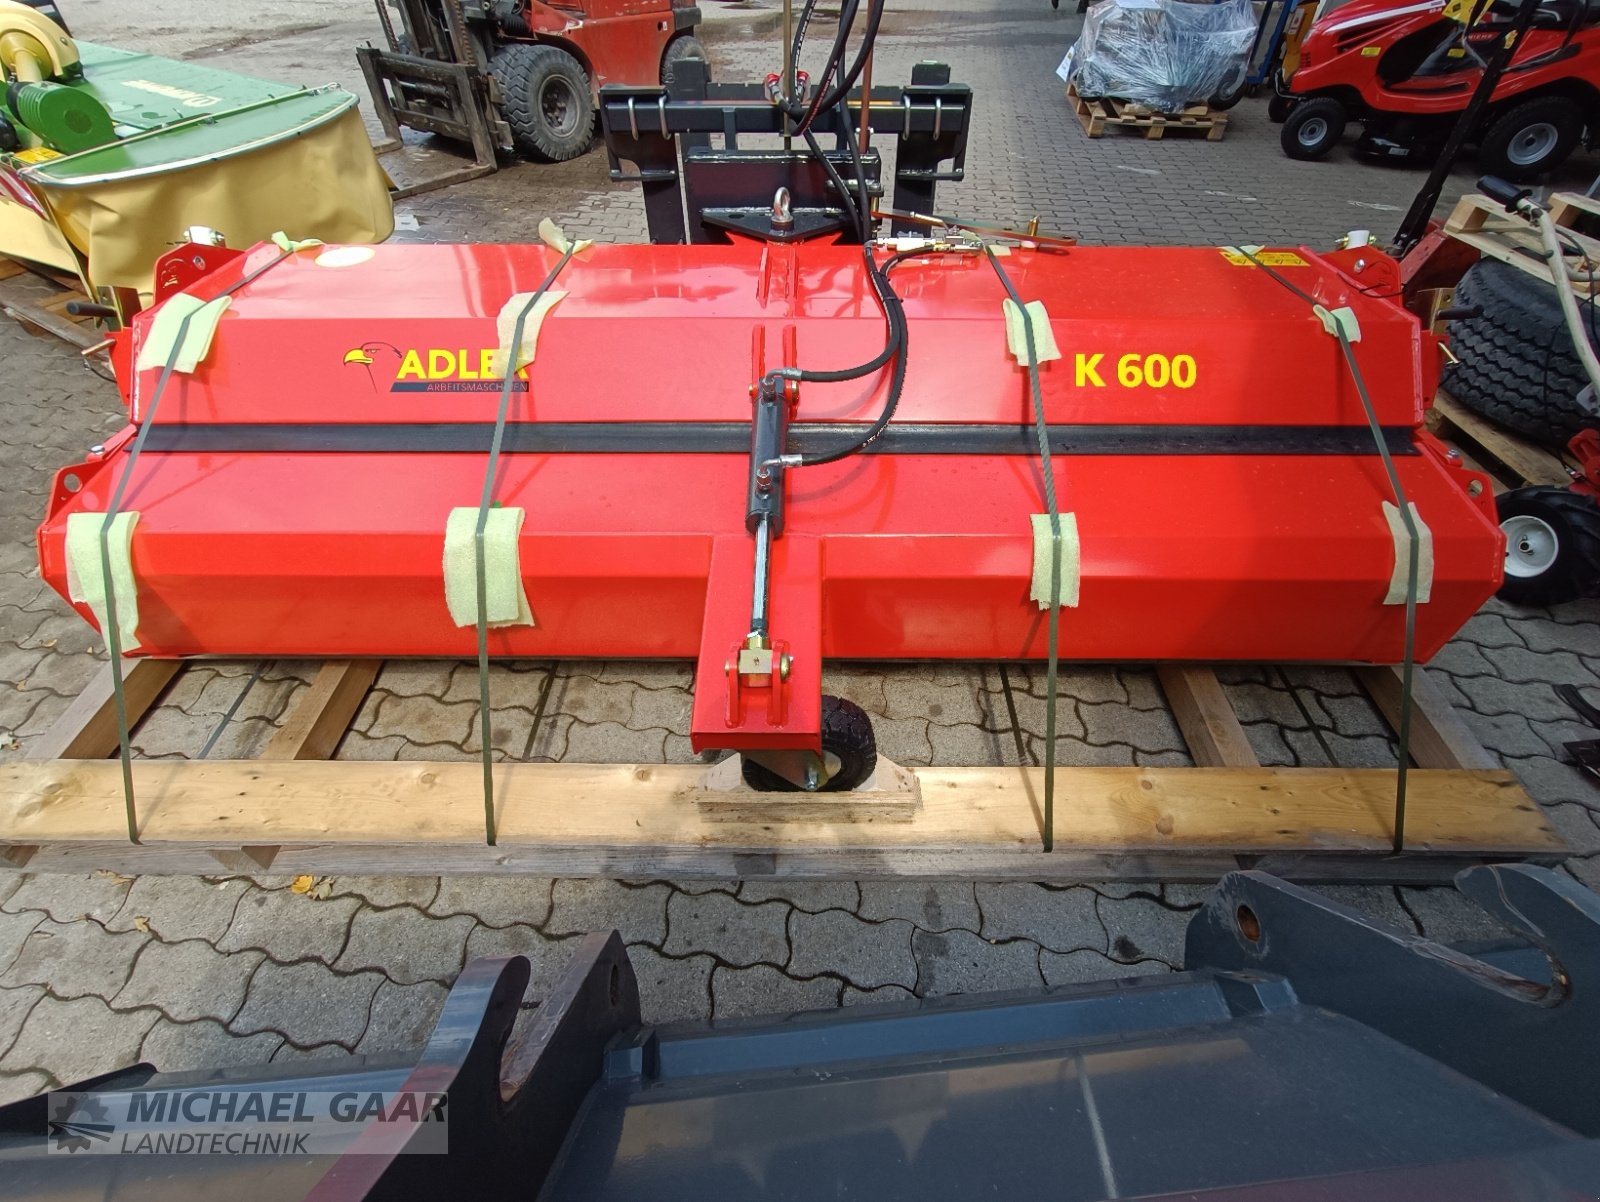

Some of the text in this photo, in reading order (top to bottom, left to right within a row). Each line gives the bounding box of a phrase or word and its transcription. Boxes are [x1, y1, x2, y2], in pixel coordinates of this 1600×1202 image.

[396, 349, 529, 379] ADLE
[1075, 353, 1197, 388] K 600
[426, 382, 528, 392] ARBEITSMASCHEN
